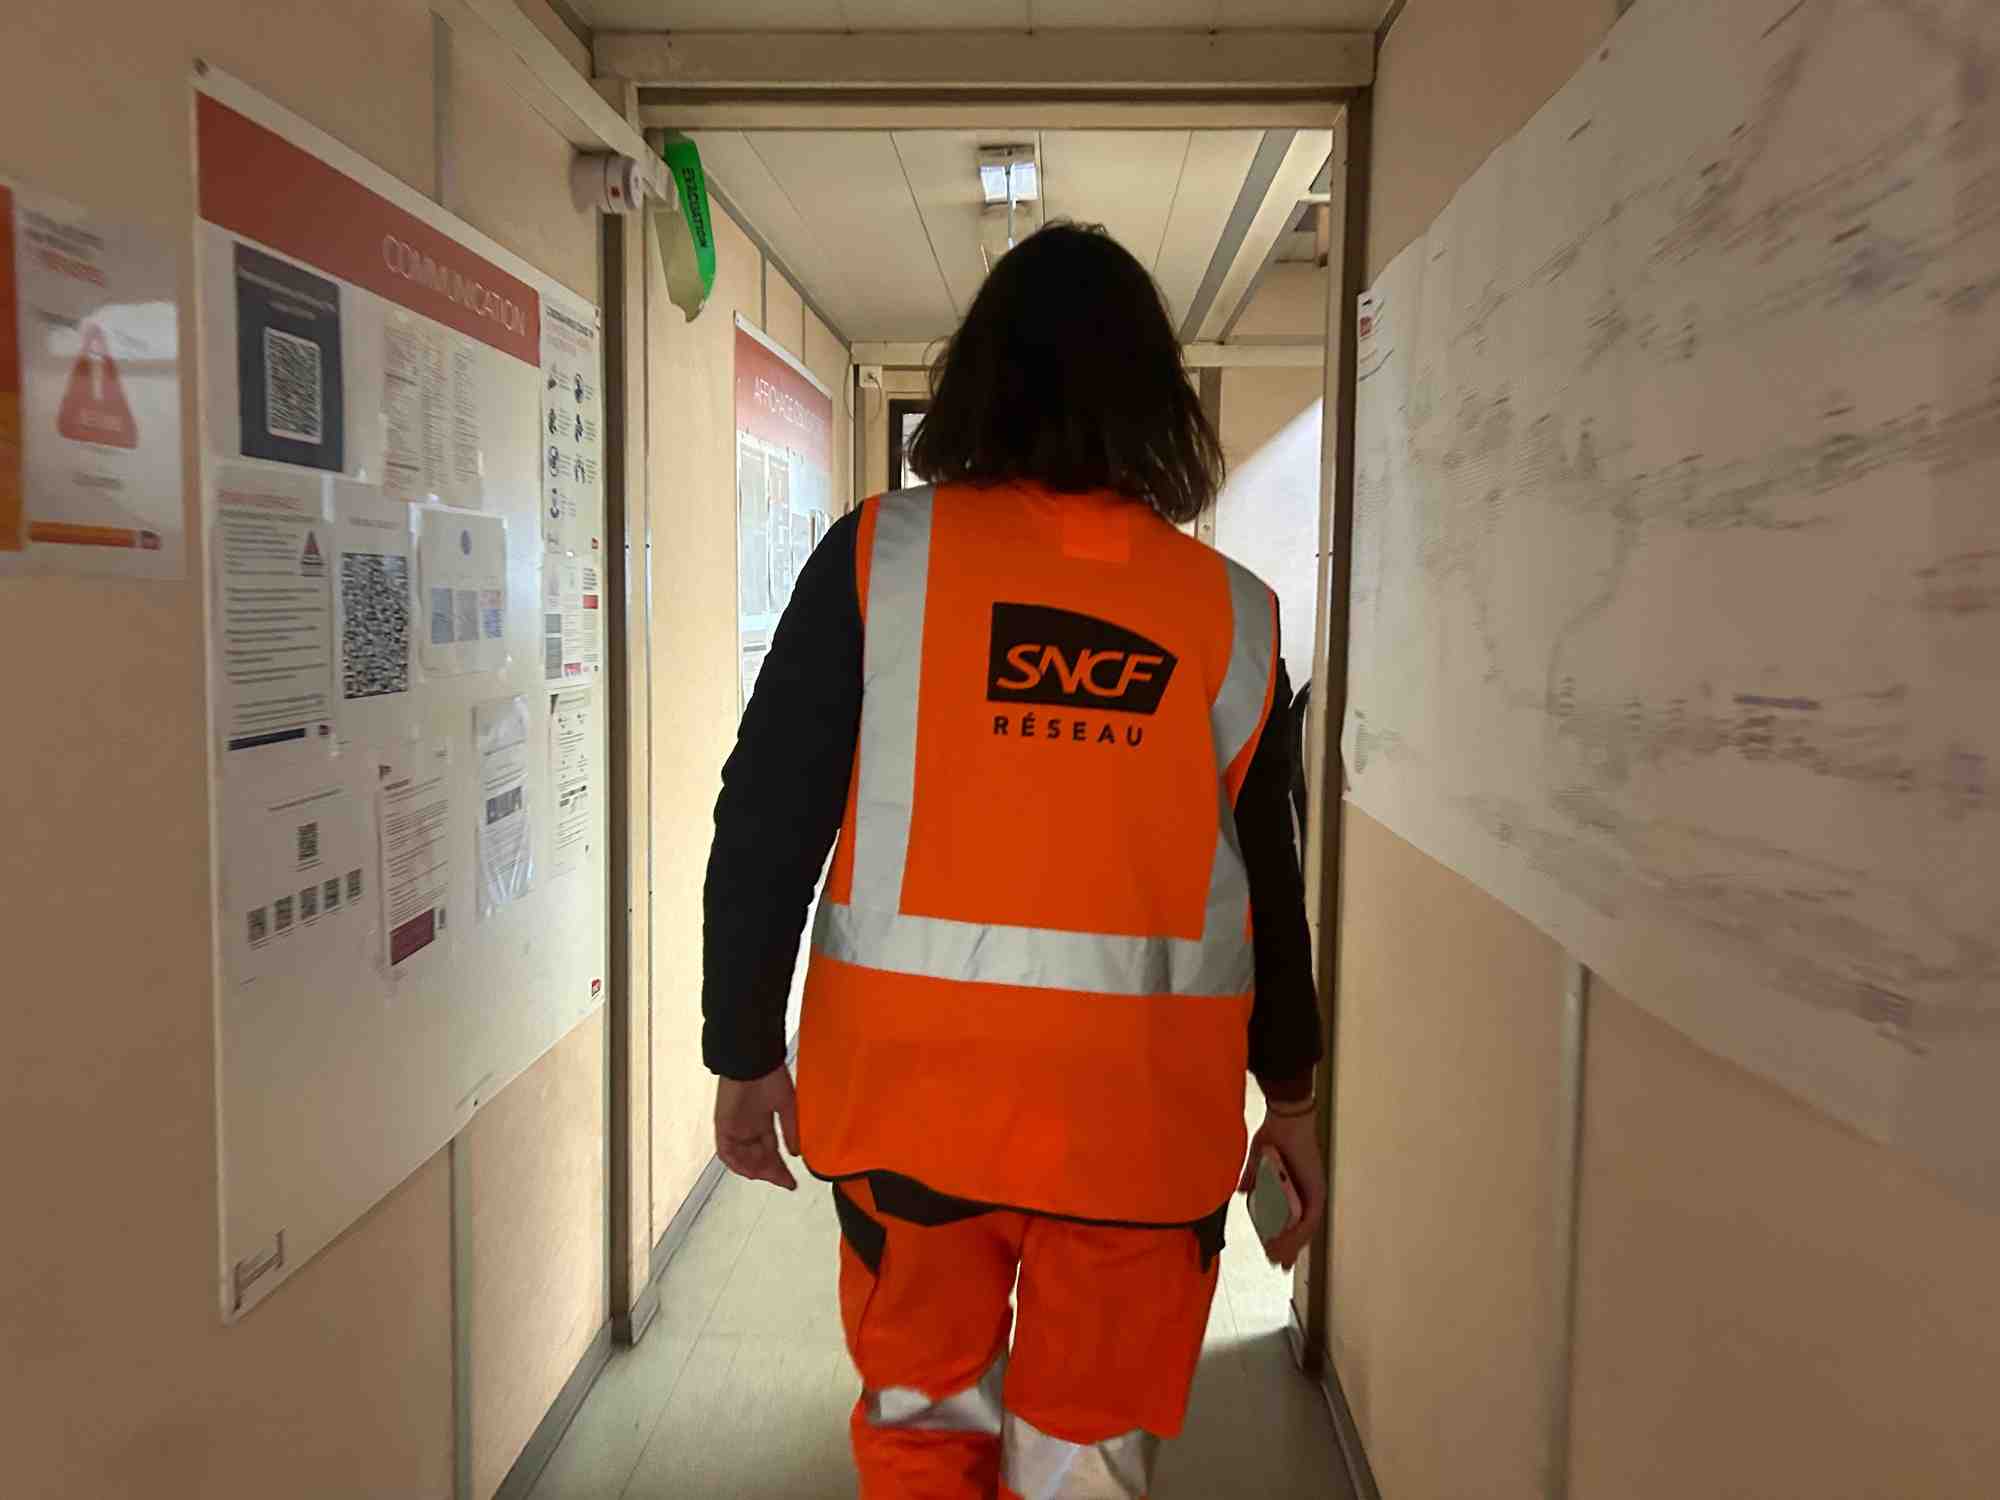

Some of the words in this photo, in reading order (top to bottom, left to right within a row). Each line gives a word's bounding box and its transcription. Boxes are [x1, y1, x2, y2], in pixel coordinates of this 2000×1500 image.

[383, 234, 526, 337] COMMUNICATION
[996, 643, 1163, 697] SNCF
[993, 712, 1143, 747] RÉSEAU
